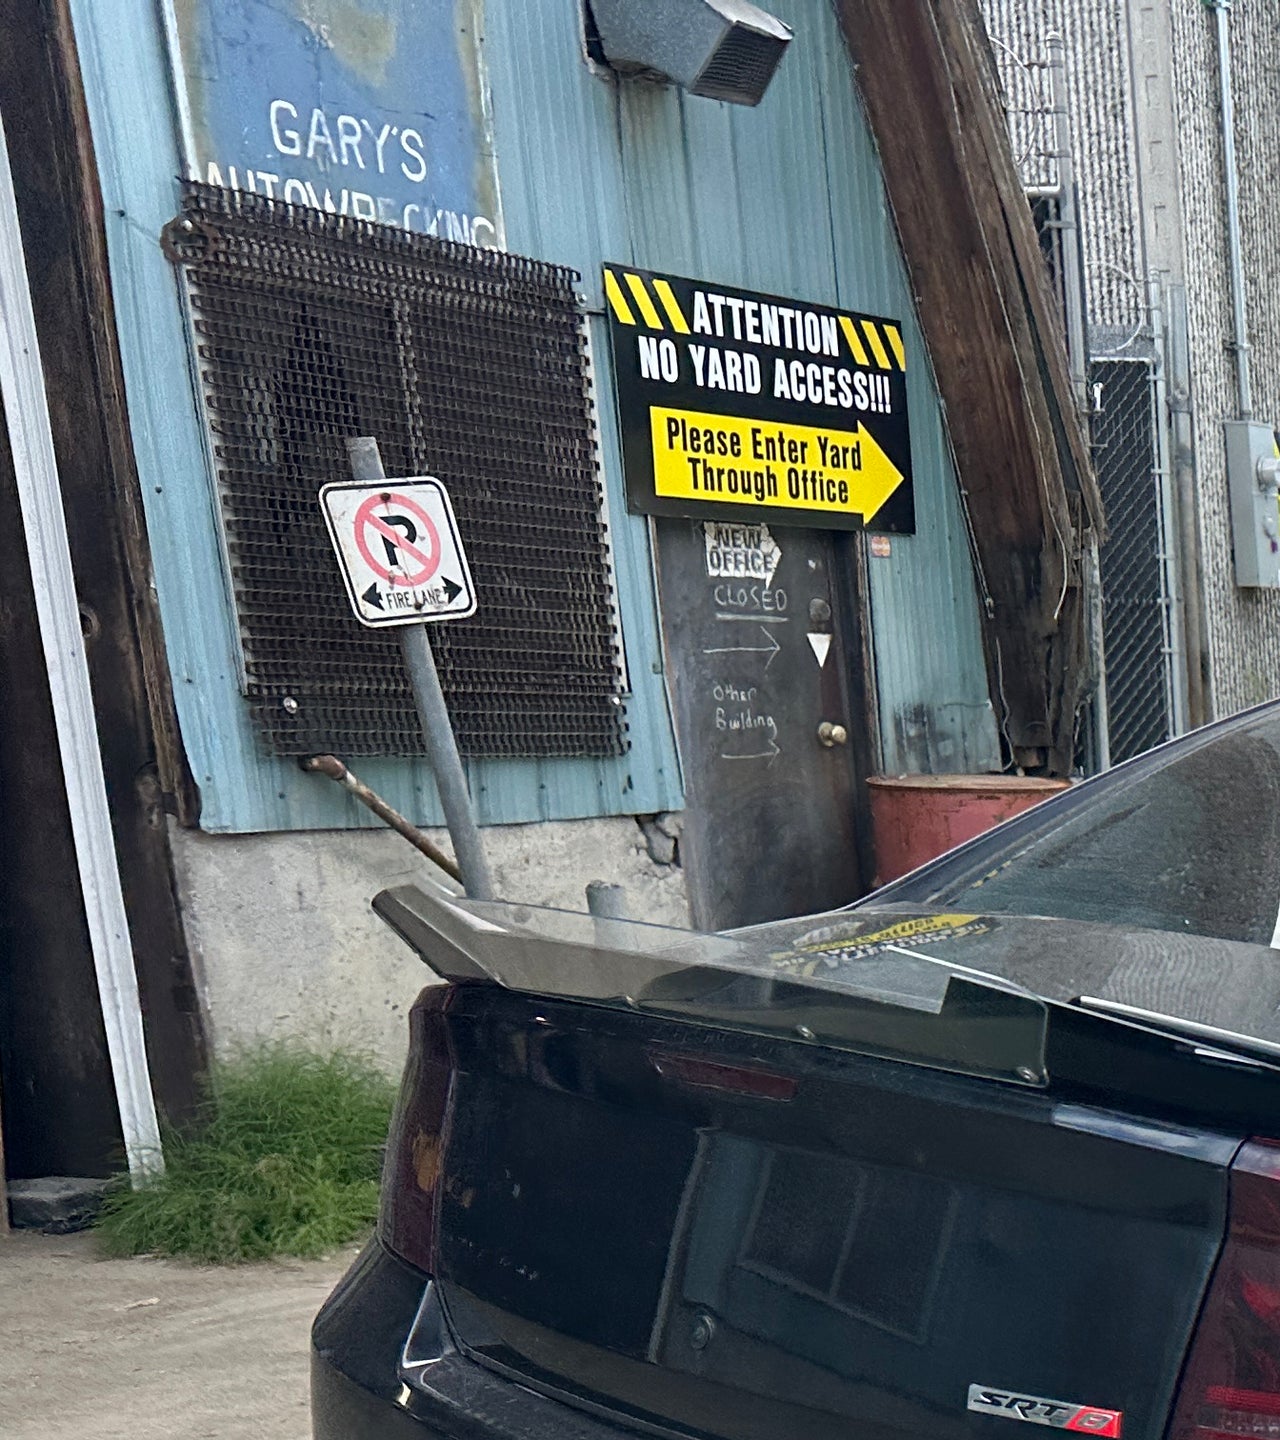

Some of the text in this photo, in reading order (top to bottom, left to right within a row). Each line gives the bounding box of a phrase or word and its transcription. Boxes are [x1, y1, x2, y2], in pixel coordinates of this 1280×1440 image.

[270, 99, 427, 182] GARY'S
[693, 291, 840, 358] ATTENTION
[638, 335, 892, 414] NO YARD ACCESS!!!
[666, 417, 862, 471] Please Enter Yard
[688, 457, 849, 504] Through Office
[709, 545, 774, 574] OFFICE
[716, 526, 761, 549] NEW
[386, 588, 446, 609] FIRE LANE
[716, 707, 778, 739] Building
